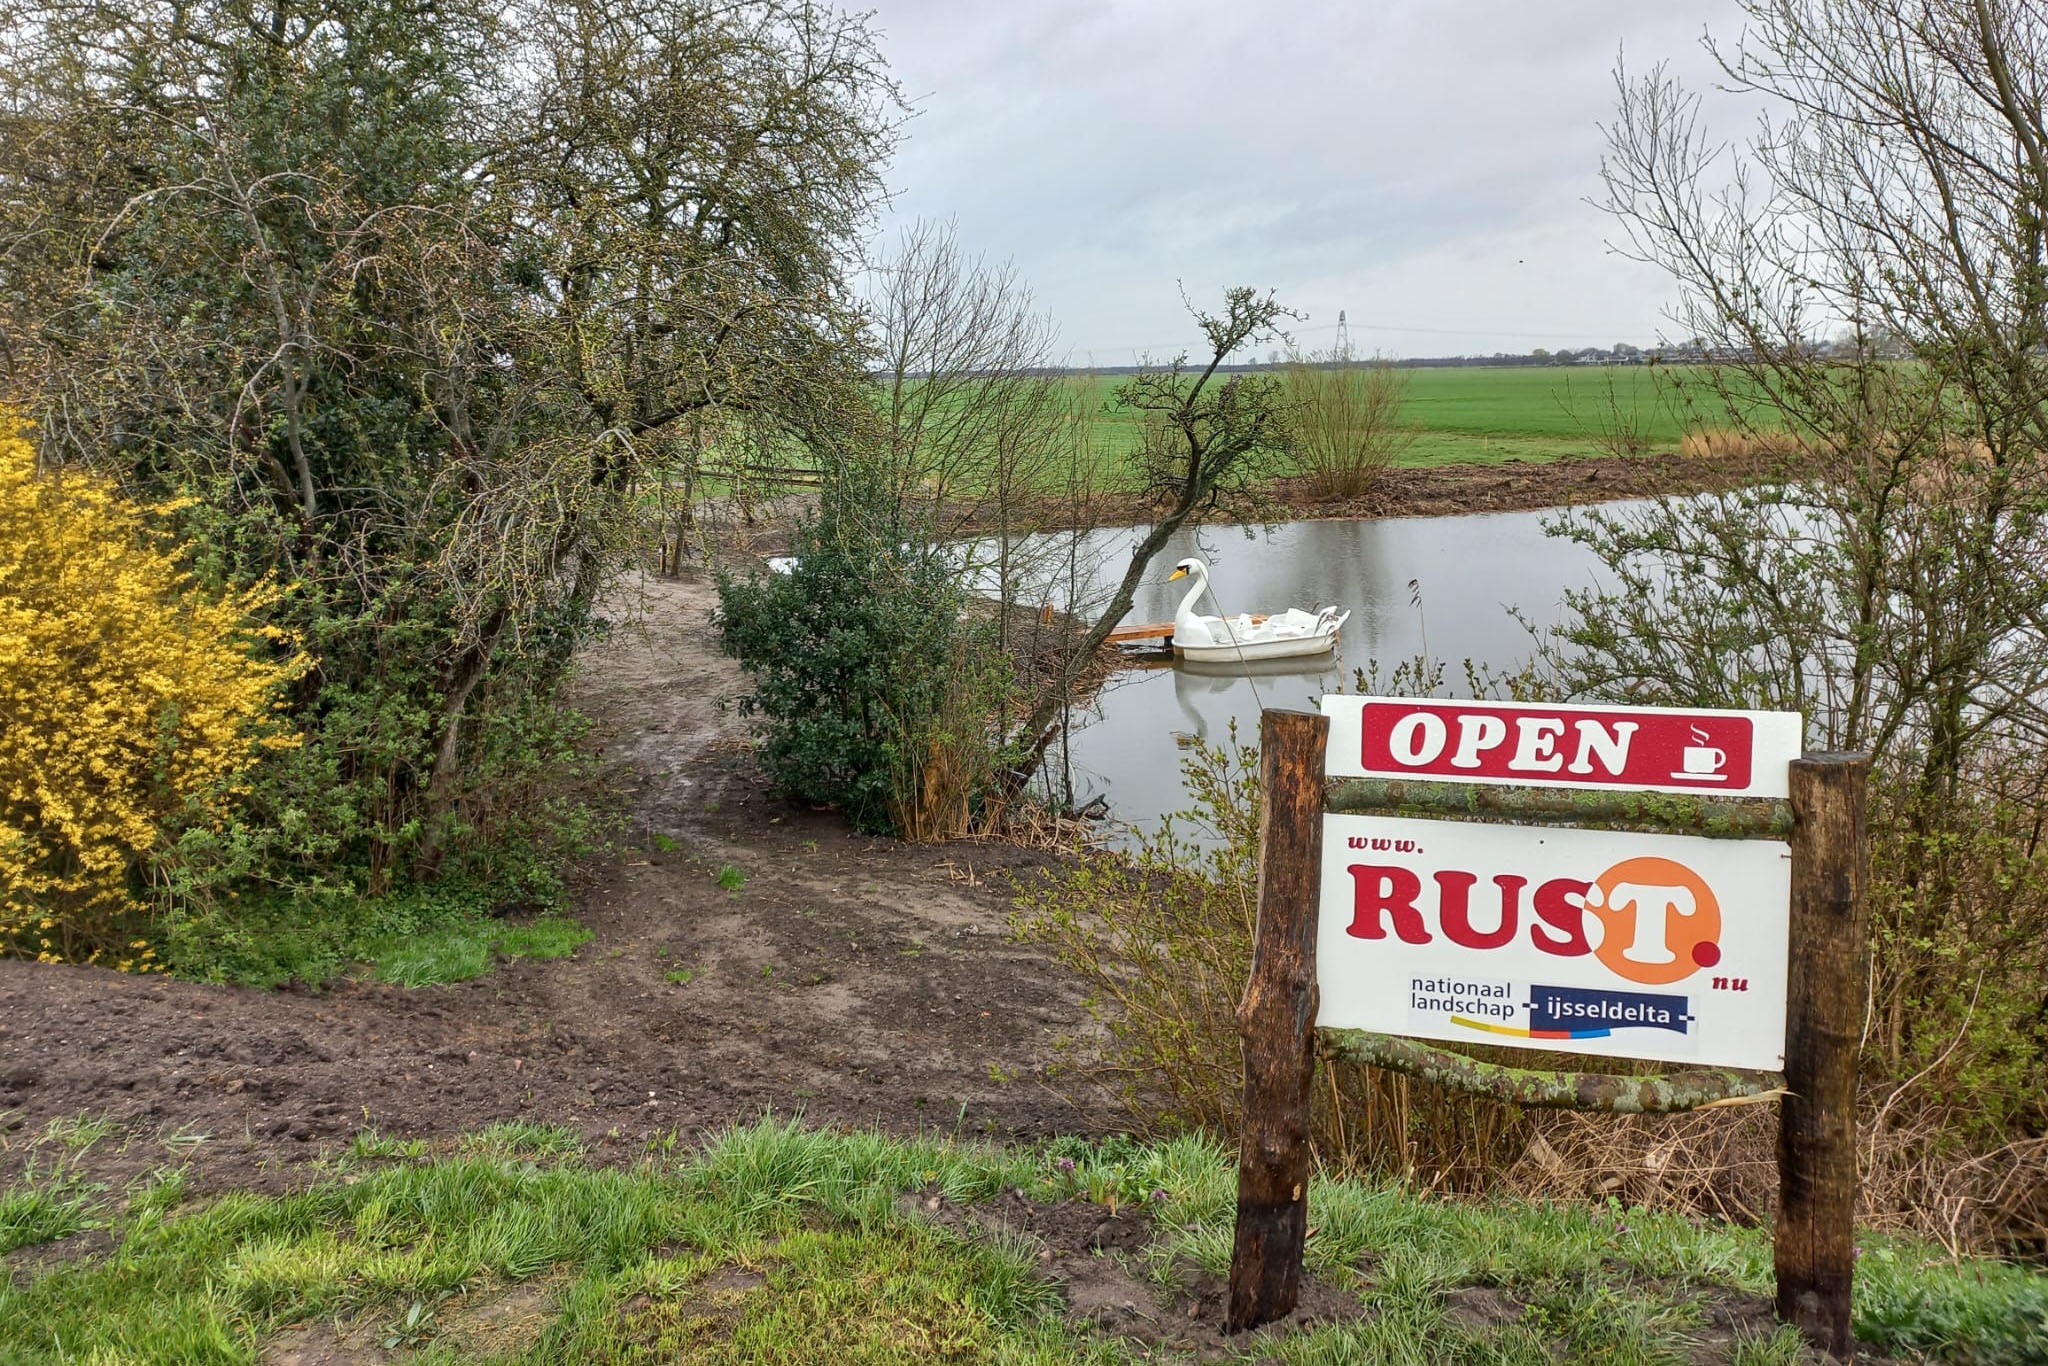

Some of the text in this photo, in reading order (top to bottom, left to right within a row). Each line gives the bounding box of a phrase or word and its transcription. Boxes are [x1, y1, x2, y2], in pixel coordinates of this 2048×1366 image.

[1389, 711, 1639, 776] OPEN
[1347, 834, 1424, 854] www.
[1412, 978, 1511, 998] nationaal
[1711, 975, 1749, 992] nu
[1412, 993, 1515, 1020] landschap
[1547, 997, 1671, 1023] ijsseldelta
